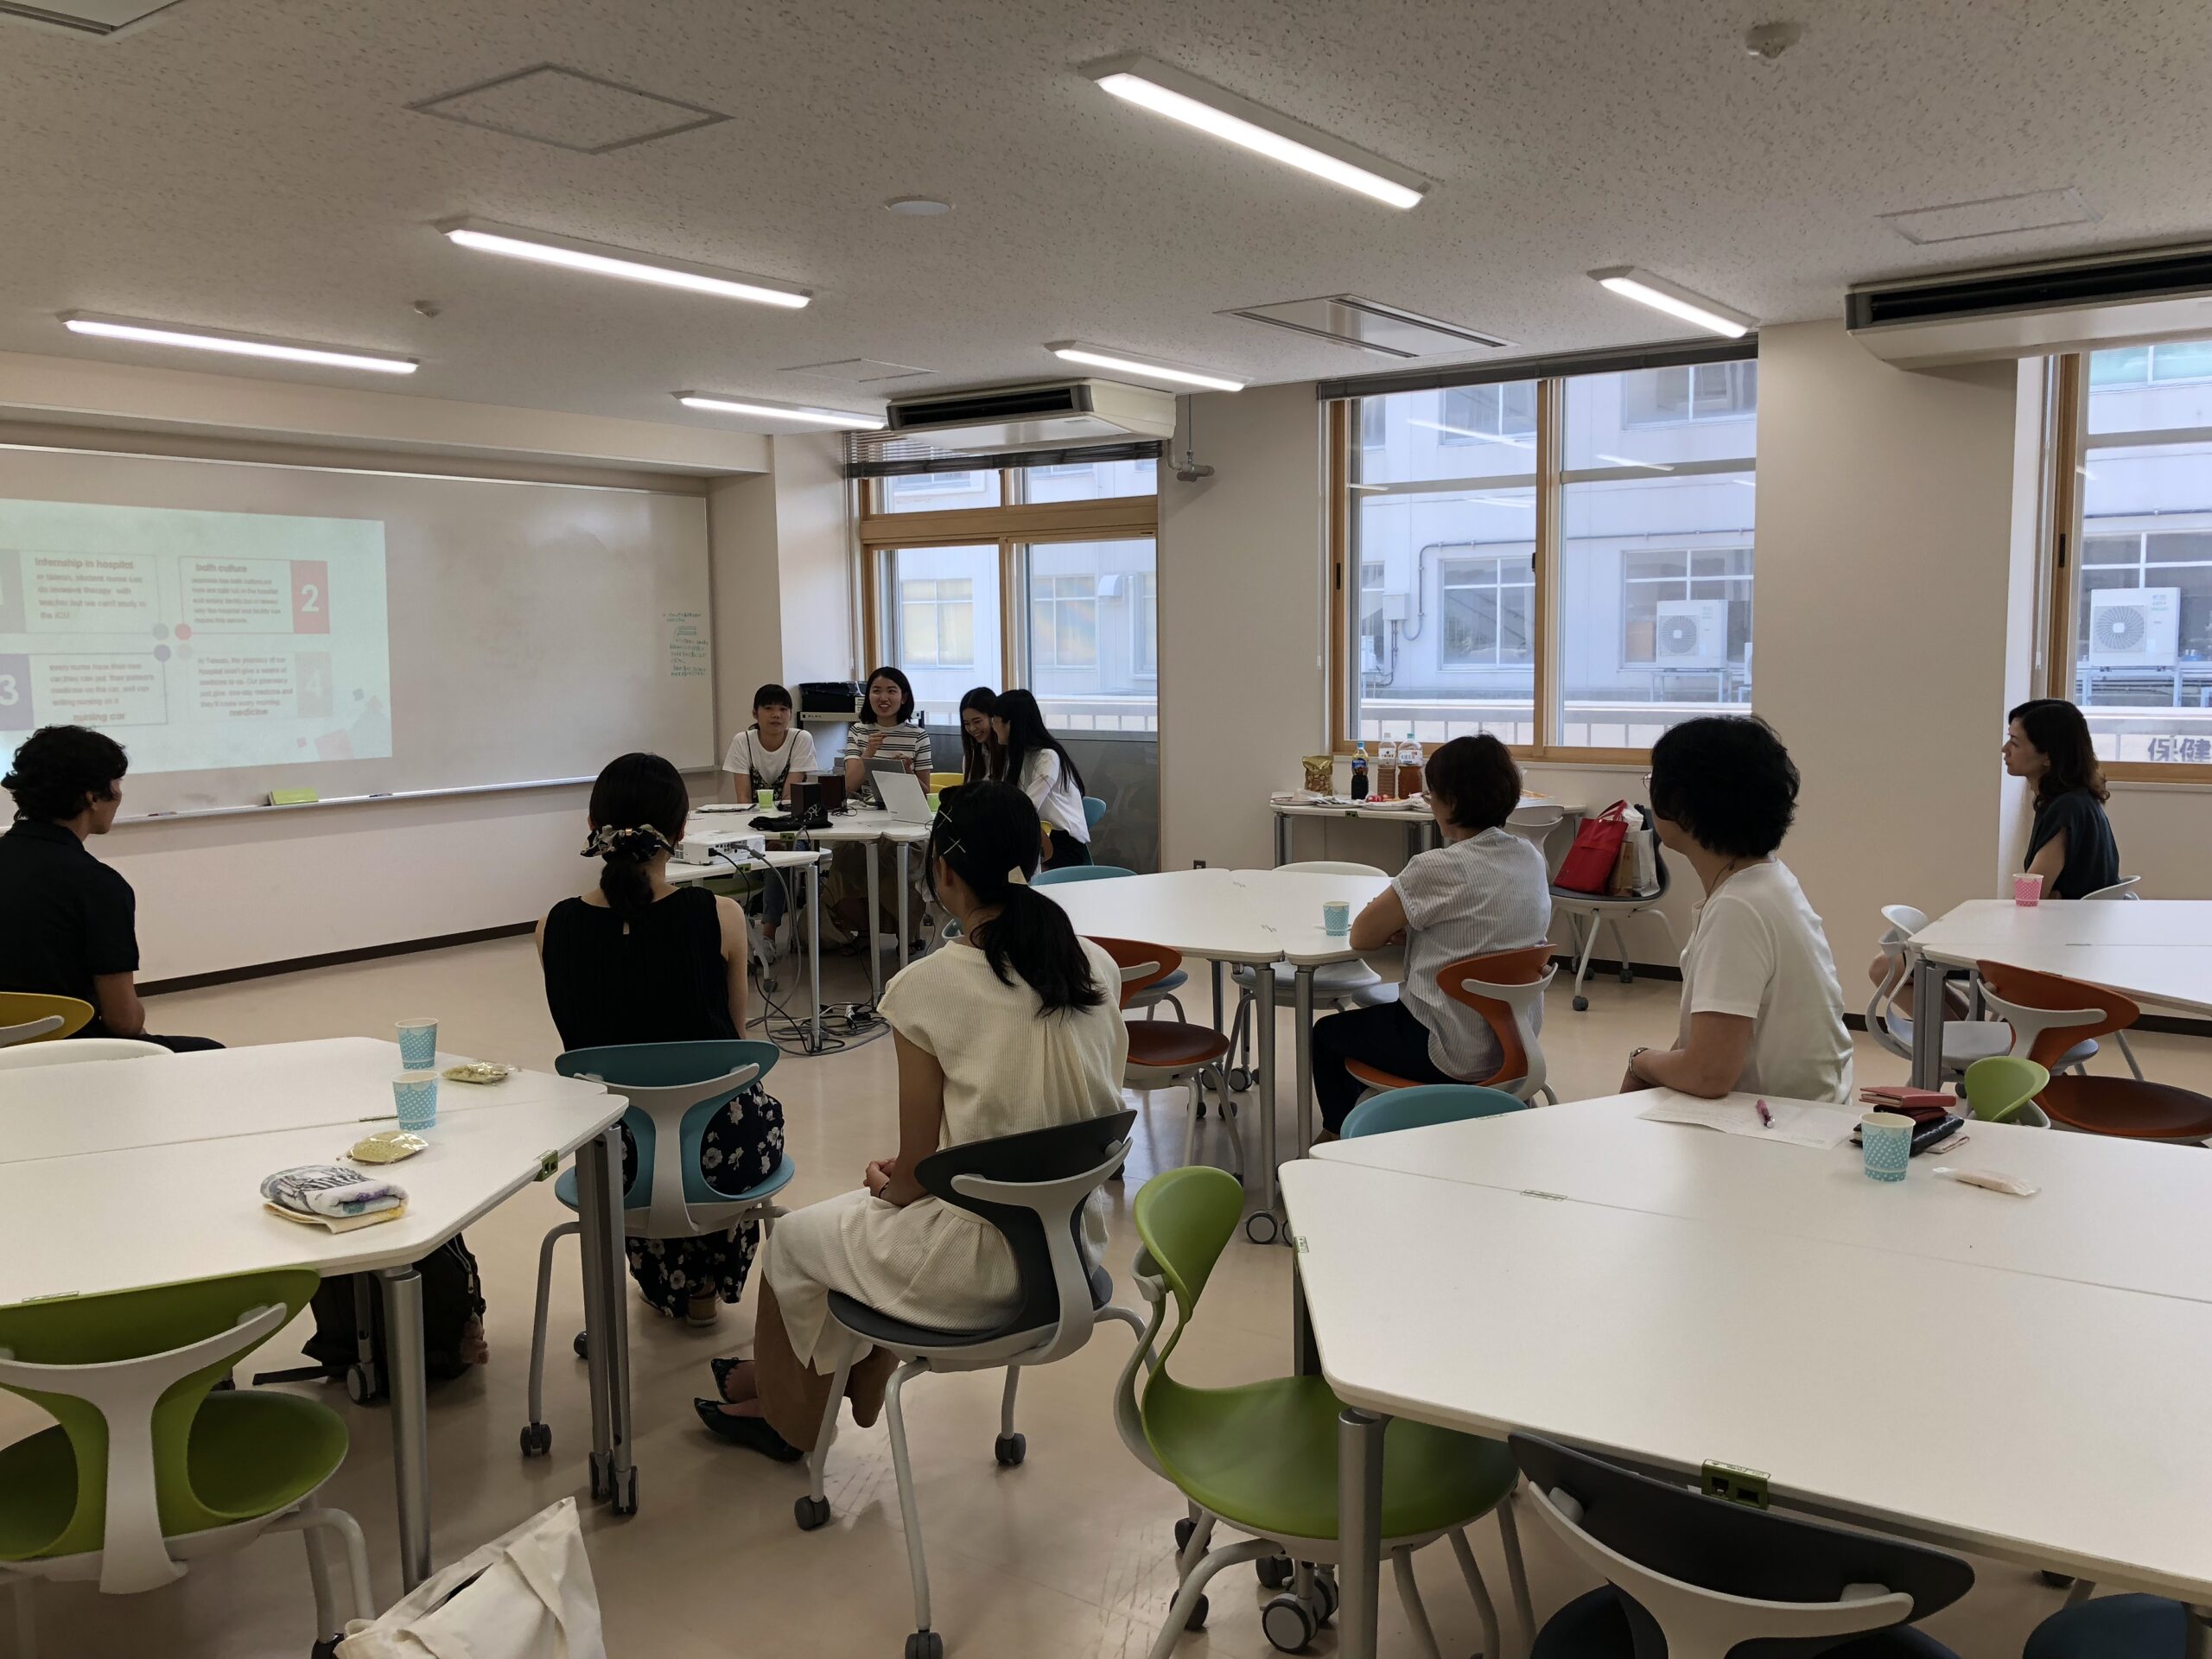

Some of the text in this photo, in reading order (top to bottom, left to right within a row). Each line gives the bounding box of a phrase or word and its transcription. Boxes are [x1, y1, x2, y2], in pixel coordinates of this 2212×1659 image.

[97, 560, 134, 570] hospital
[301, 583, 320, 613] 2
[0, 674, 19, 706] 3
[304, 669, 324, 697] 4
[2147, 737, 2211, 762] 保健
